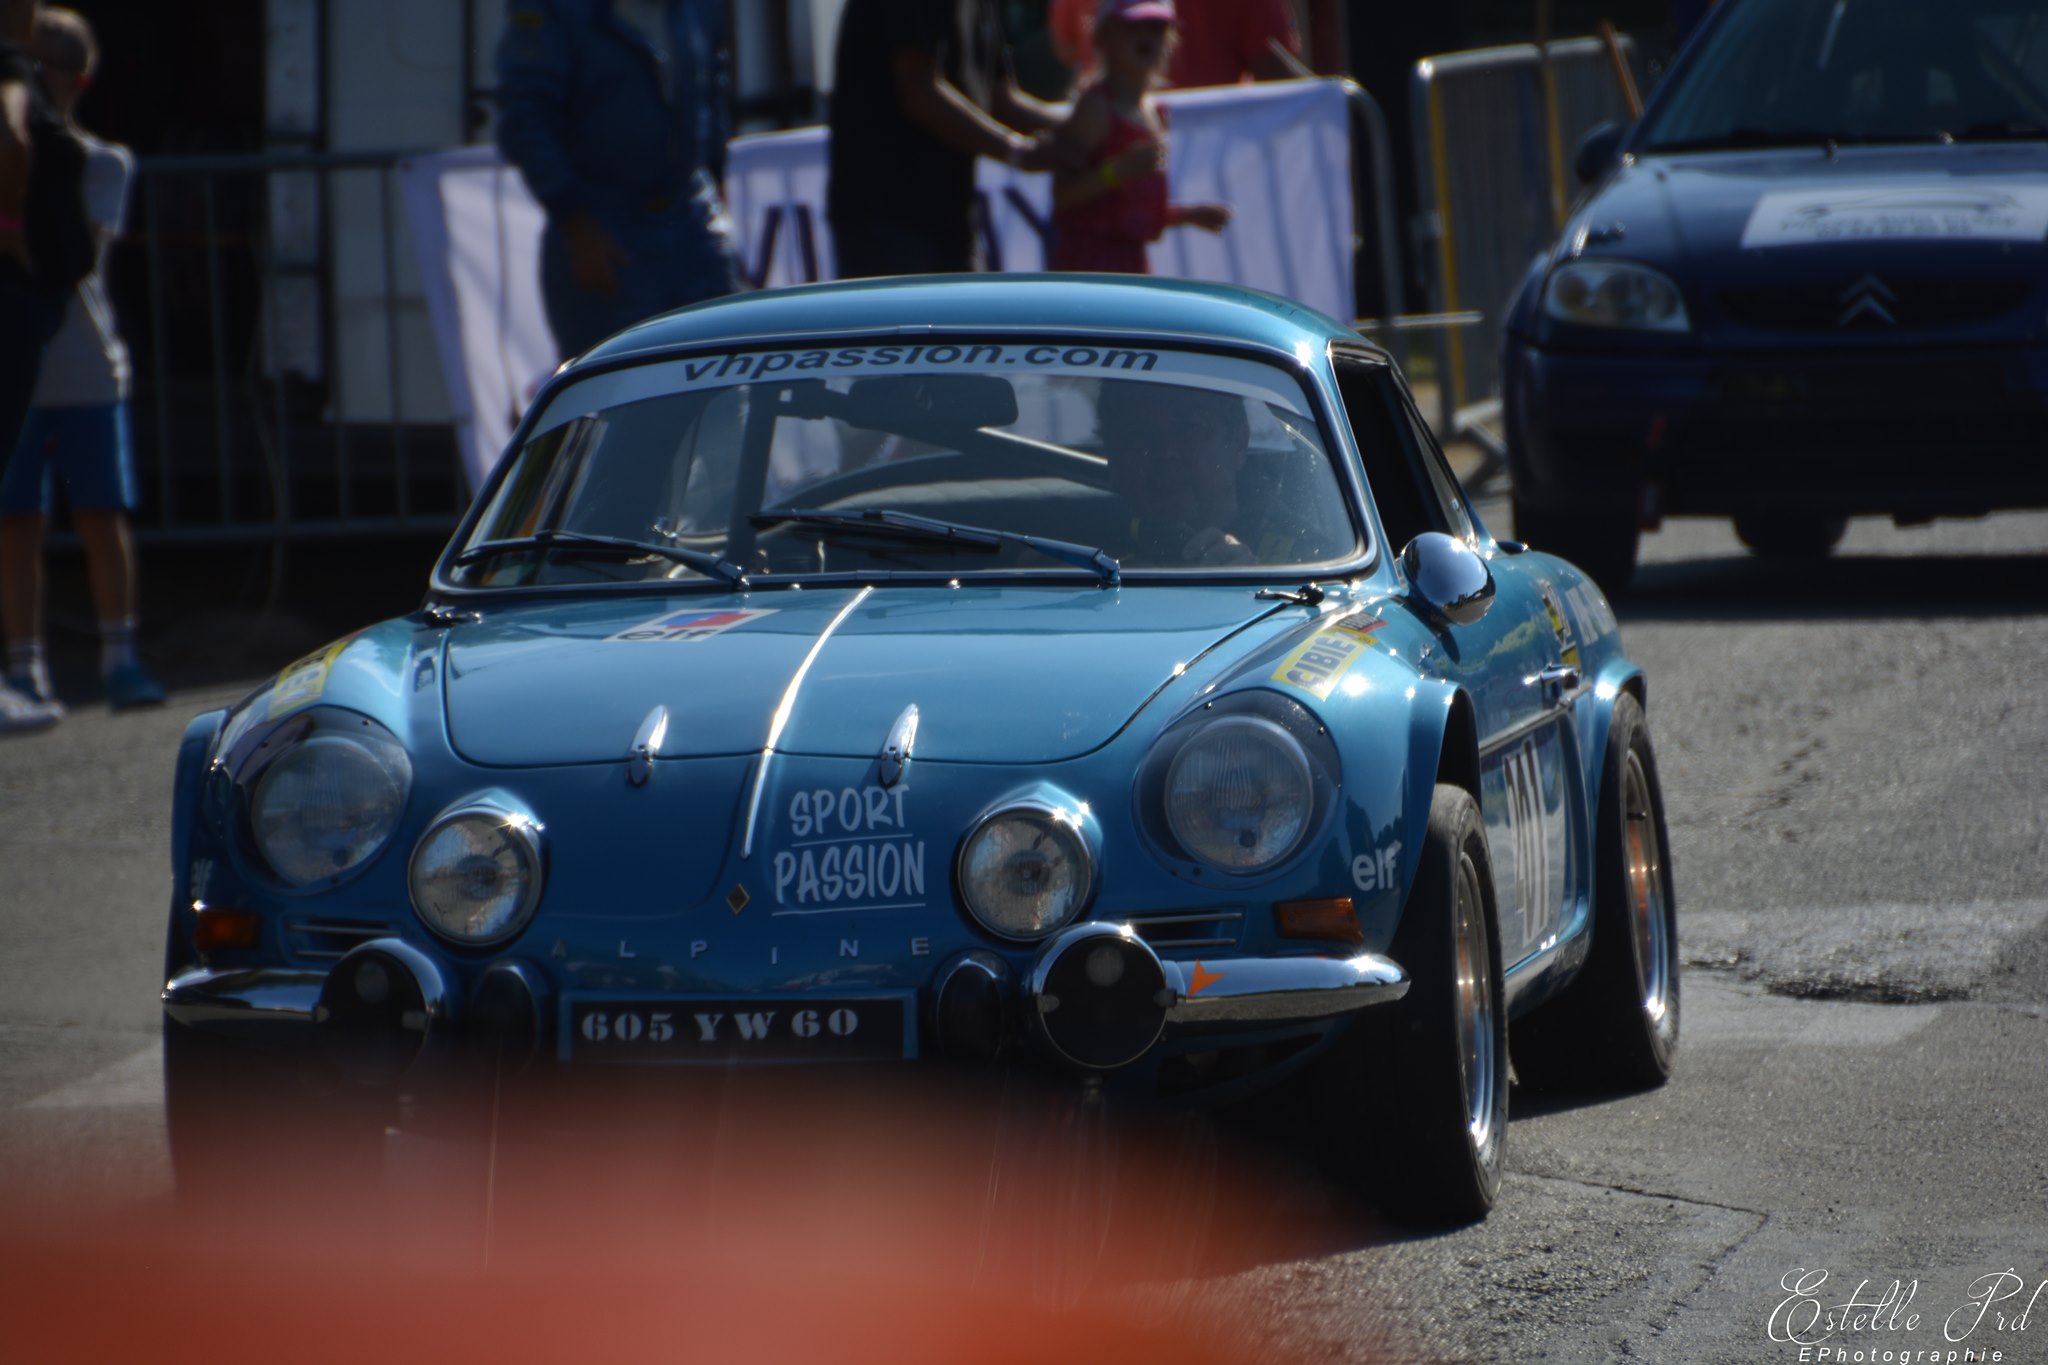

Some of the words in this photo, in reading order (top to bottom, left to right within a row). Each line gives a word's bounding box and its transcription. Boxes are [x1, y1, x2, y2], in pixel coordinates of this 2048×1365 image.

[684, 344, 1159, 382] vhpassion.com
[789, 784, 910, 837] SPORT
[773, 841, 925, 904] PASSION
[1352, 839, 1402, 891] elf
[550, 937, 931, 965] ALPINE
[581, 1011, 674, 1042] 605
[694, 1011, 777, 1042] YW
[790, 1007, 859, 1039] 60
